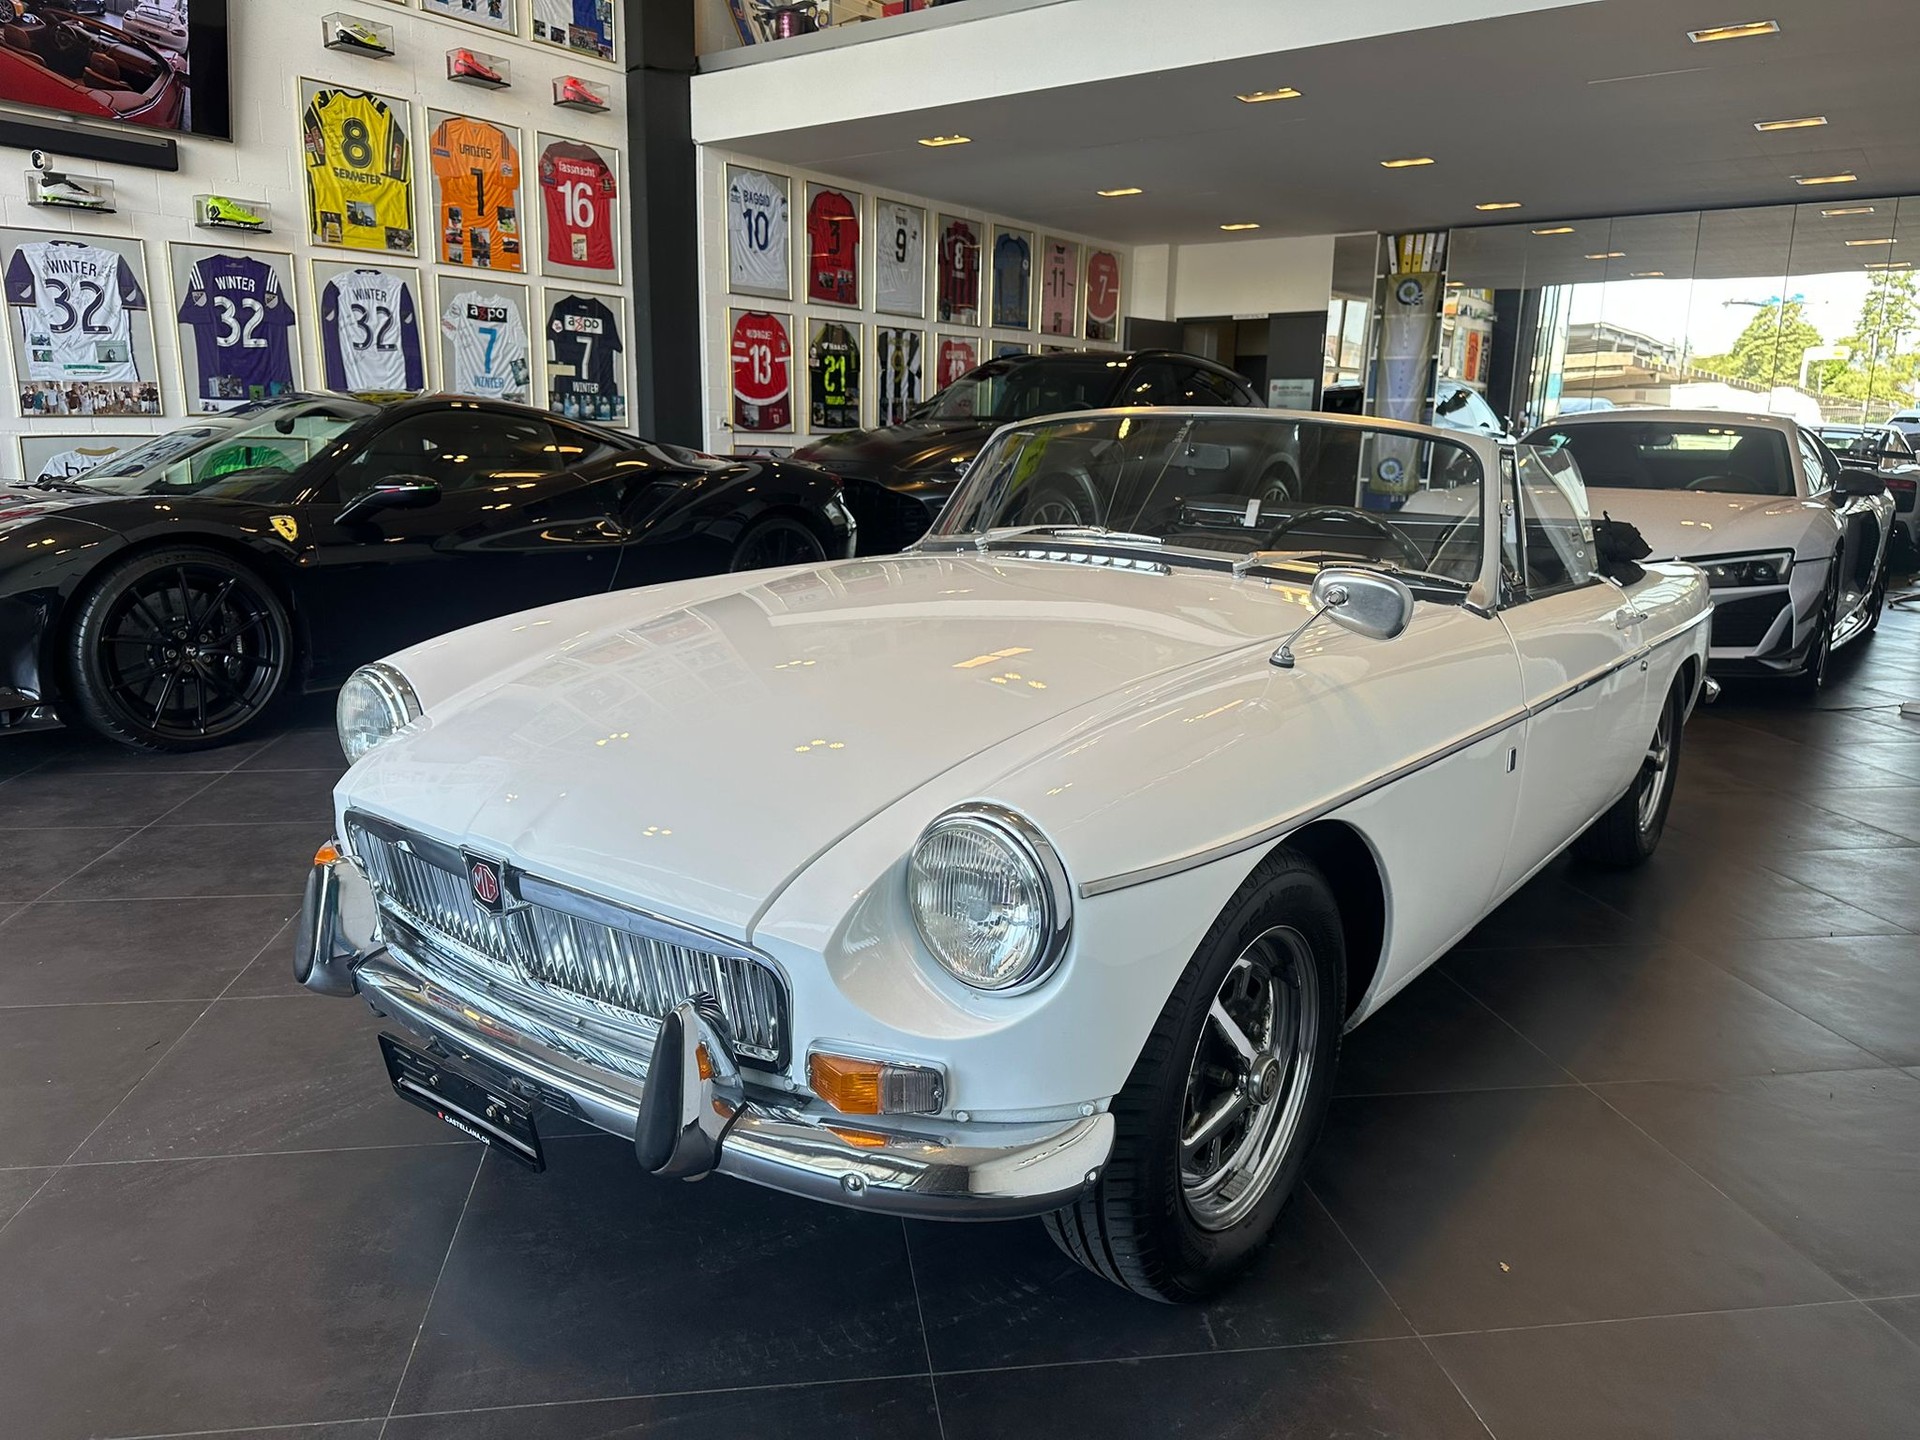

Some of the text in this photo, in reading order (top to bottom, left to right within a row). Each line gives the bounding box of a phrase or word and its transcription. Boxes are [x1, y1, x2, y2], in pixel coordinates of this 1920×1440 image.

[342, 118, 372, 169] 8
[470, 167, 484, 216] 1
[557, 180, 595, 228] 16
[743, 208, 769, 251] 10
[828, 220, 840, 255] 3
[895, 228, 906, 263] 9
[48, 259, 97, 277] WINTER
[954, 241, 964, 270] 8
[215, 275, 256, 293] WINTER
[352, 288, 387, 303] WINTER
[1052, 266, 1065, 298] 11
[1099, 275, 1108, 305] 7
[45, 278, 112, 334] 32
[213, 296, 268, 347] 32
[351, 303, 398, 352] 32
[478, 327, 498, 374] 7
[576, 336, 592, 380] 7
[749, 344, 772, 385] 13
[474, 376, 505, 389] WINTER
[572, 381, 599, 393] WINTER
[824, 355, 846, 392] 21
[474, 866, 496, 899] MG
